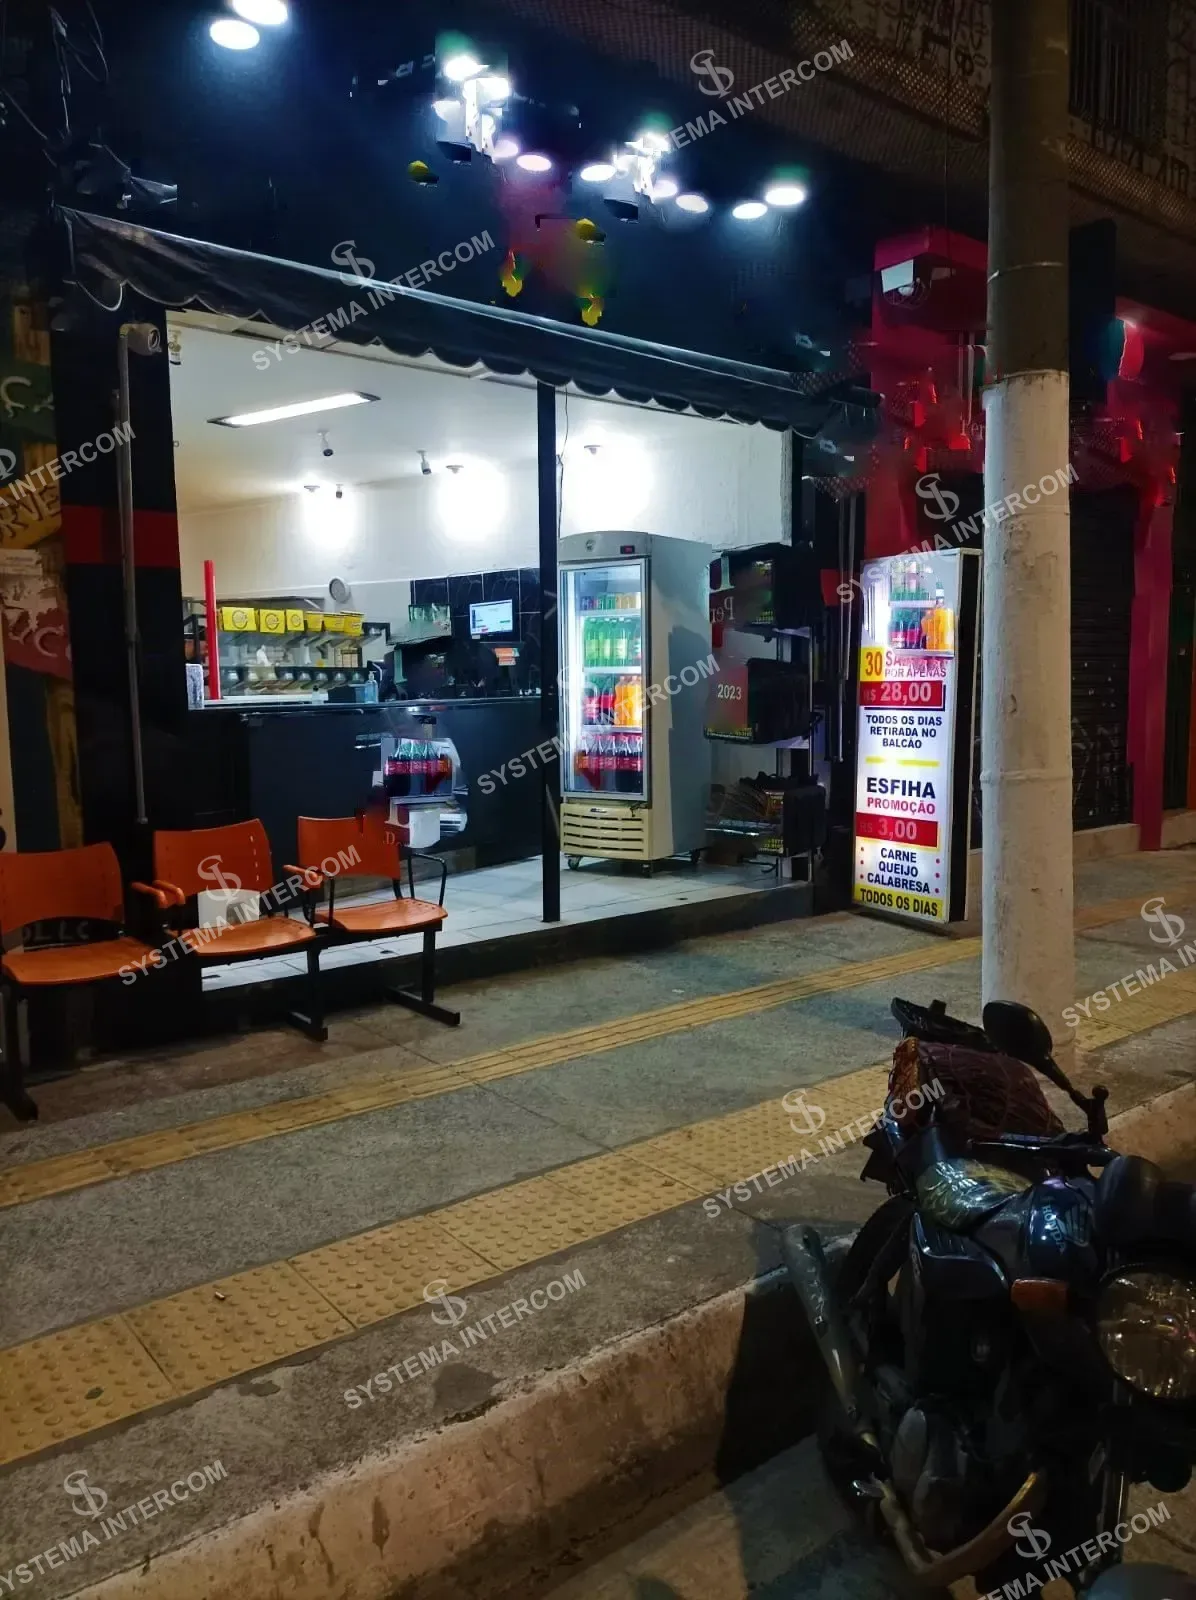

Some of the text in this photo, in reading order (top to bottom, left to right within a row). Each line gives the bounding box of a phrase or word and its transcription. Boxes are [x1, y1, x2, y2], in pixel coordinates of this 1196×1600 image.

[865, 651, 883, 677] 30
[906, 667, 947, 678] APENAS
[717, 684, 742, 700] 2023
[880, 682, 932, 705] 28,00
[866, 714, 942, 726] TODOS OS DIAS
[870, 726, 937, 738] RETIRADA NO
[882, 736, 922, 748] BALCÃO
[866, 777, 936, 799] ESFIHA
[867, 797, 936, 815] PROMOÇÃO
[878, 817, 917, 841] 3,00
[880, 847, 917, 863] CARNE
[878, 861, 919, 877] QUEIJO
[867, 872, 931, 894] CALABRESA
[860, 888, 938, 917] TODOS OS DIAS
